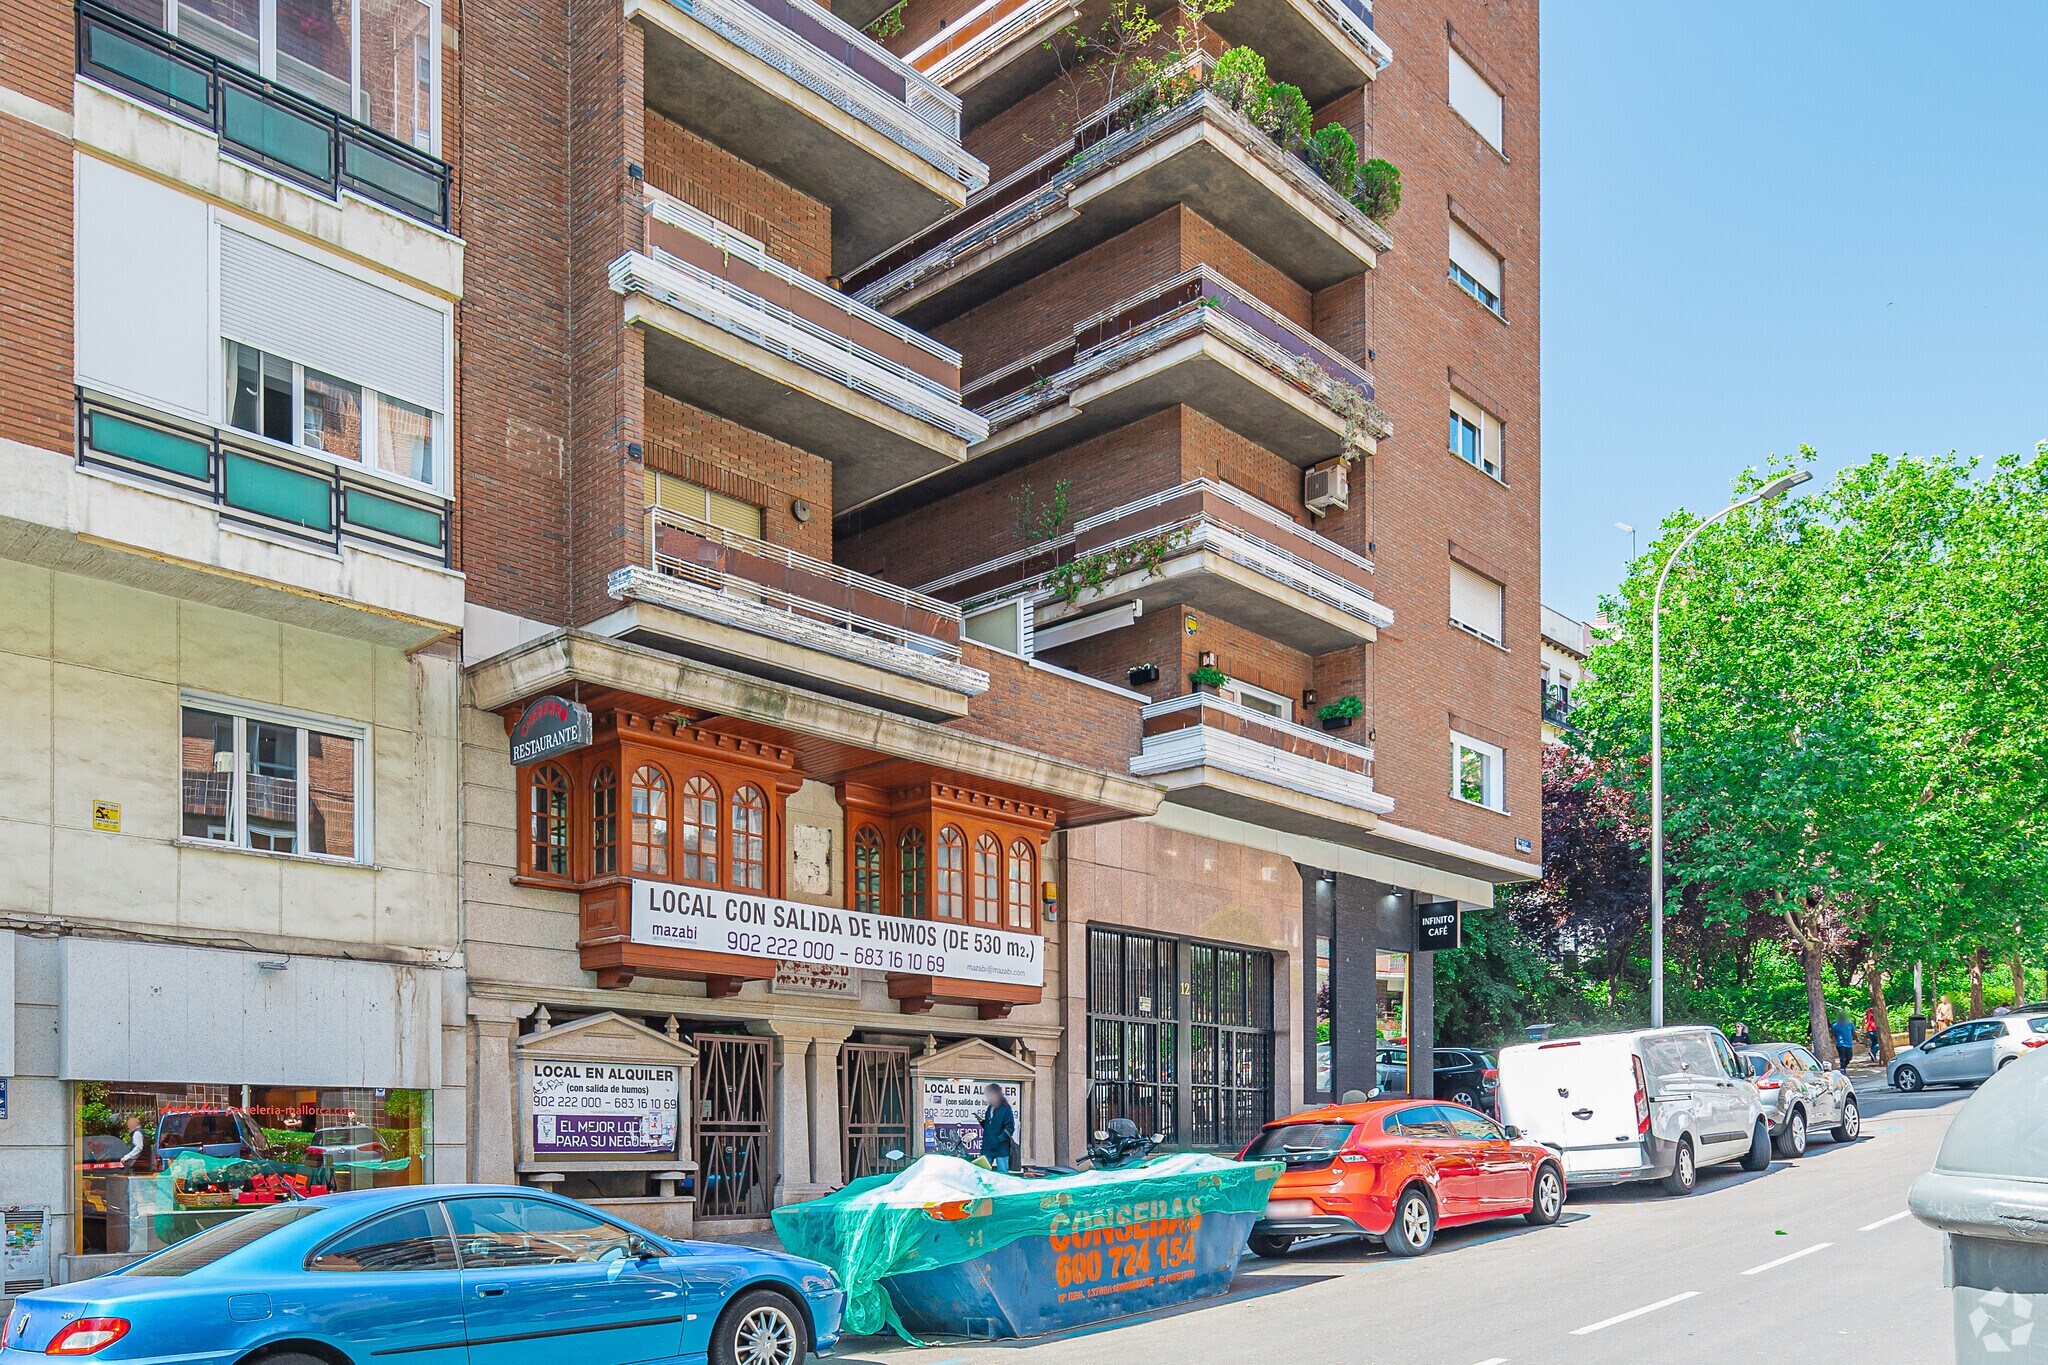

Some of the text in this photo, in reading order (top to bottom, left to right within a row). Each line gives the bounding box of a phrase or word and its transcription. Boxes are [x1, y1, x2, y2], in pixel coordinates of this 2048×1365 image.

[513, 725, 578, 760] RESTAURANTE
[650, 888, 717, 918] LOCAL
[725, 898, 766, 926] CON
[773, 905, 843, 935] SALIDA
[848, 916, 872, 938] DE
[878, 920, 936, 947] HUMOS
[943, 928, 968, 952] (DE
[974, 934, 1000, 955] 530
[1422, 914, 1454, 926] INFINITO
[652, 924, 698, 940] mazabi
[1428, 925, 1448, 936] CAFÉ
[728, 932, 760, 952] 902
[766, 936, 798, 957] 222
[803, 940, 834, 960] 000
[854, 946, 883, 966] 683
[888, 950, 903, 968] 16
[908, 952, 922, 970] 10
[926, 956, 945, 972] 69
[966, 963, 1026, 977] mazabi@mazabi.com
[1180, 982, 1190, 995] 12
[534, 1065, 674, 1082] LOCAL EN ALQUILER
[566, 1084, 584, 1094] (con
[586, 1084, 608, 1093] salida
[610, 1085, 620, 1093] de
[622, 1086, 649, 1096] humos)
[924, 1084, 1016, 1096] LOCAL EN ALER
[534, 1096, 554, 1107] 902
[558, 1096, 578, 1107] 222
[581, 1097, 602, 1108] 000
[614, 1098, 634, 1108] 683
[638, 1098, 648, 1108] 16
[651, 1098, 660, 1109] 10
[664, 1099, 677, 1110] 69
[946, 1098, 957, 1106] (con
[958, 1098, 974, 1106] salida
[924, 1108, 938, 1117] 902
[940, 1108, 954, 1118] 222
[955, 1109, 968, 1118] 000
[560, 1120, 642, 1133] EL MEJOR LOC
[556, 1136, 650, 1147] PARA SU NEGO
[1056, 1234, 1196, 1288] 600 724 154
